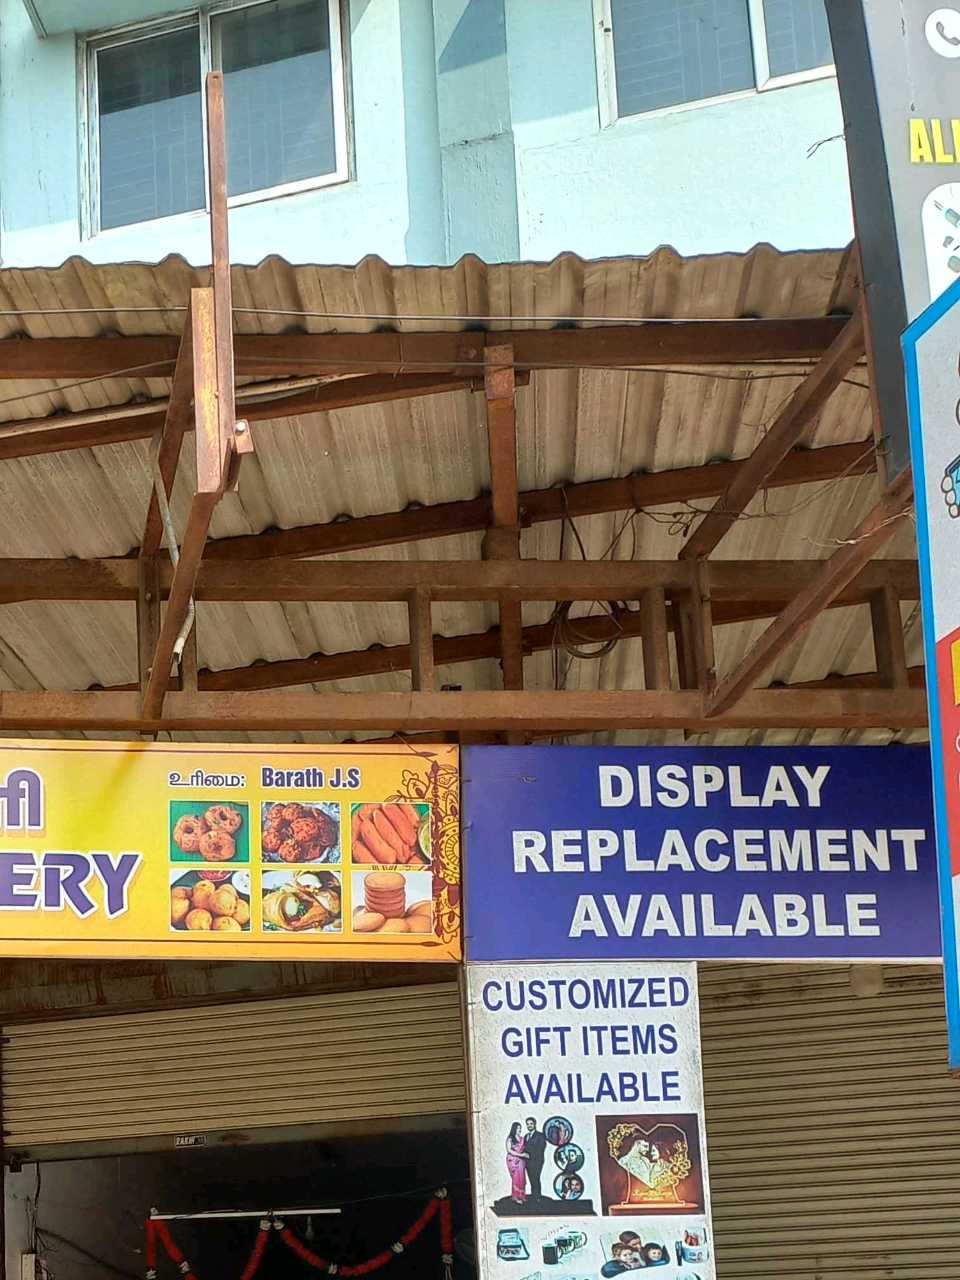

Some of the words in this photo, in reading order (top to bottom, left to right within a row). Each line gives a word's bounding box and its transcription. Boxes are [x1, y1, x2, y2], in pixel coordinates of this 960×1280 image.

[168, 770, 245, 788] உரிமை:
[261, 766, 323, 788] Barath
[329, 767, 360, 788] J.S
[597, 764, 832, 808] DISPLAY
[511, 828, 926, 873] REPLACEMENT
[567, 893, 882, 938] AVAILABLE
[481, 975, 690, 1012] CUSTOMIZED
[500, 1025, 571, 1058] GIFT
[581, 1022, 679, 1057] ITEMS
[503, 1069, 682, 1105] AVAILABLE
